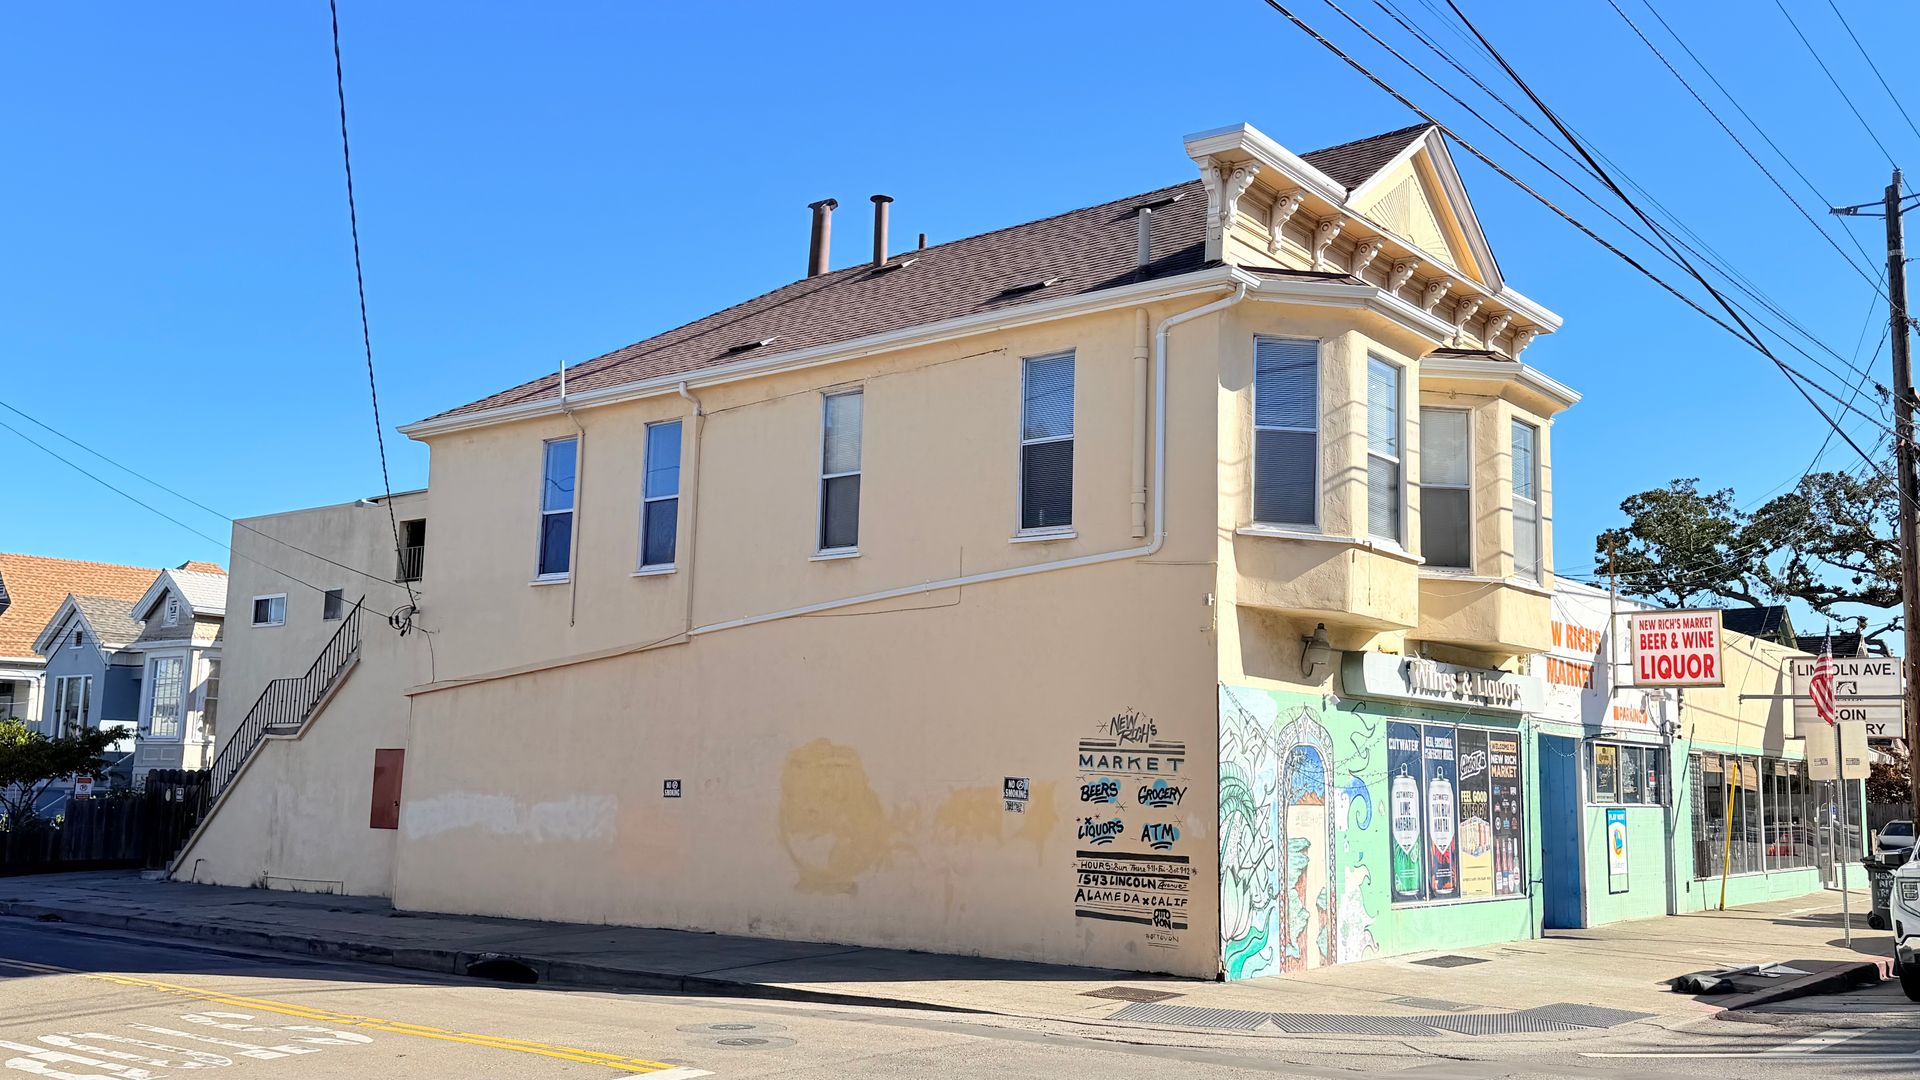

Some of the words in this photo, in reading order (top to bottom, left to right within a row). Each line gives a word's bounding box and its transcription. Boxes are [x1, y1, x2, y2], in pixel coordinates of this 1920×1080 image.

[1639, 620, 1656, 630] NEW
[1658, 619, 1681, 629] RICH'S
[1682, 617, 1713, 628] MARKET
[1566, 623, 1602, 655] RICH'S
[1640, 633, 1667, 650] BEER
[1671, 632, 1678, 649] &
[1682, 631, 1714, 648] WINE
[1546, 656, 1595, 690] MARKET
[1641, 654, 1715, 679] LIQUOR
[1797, 664, 1859, 676] LINOLN
[1863, 664, 1896, 676] AVE.
[1462, 671, 1473, 696] &
[1477, 675, 1521, 704] Liquors
[1109, 712, 1140, 736] NEW
[1388, 738, 1420, 752] CUTWATER
[1079, 754, 1185, 771] MARKET
[1491, 754, 1504, 764] NEW
[1505, 754, 1517, 765] RICH
[1491, 764, 1517, 778] MARKET
[1005, 789, 1027, 799] SMOKING
[1080, 782, 1119, 802] BEERS
[1138, 785, 1188, 806] GROCERY
[1460, 790, 1471, 802] FEEL
[1472, 790, 1488, 803] GOOD
[1141, 823, 1175, 843] ATM
[1079, 874, 1108, 886] 1543
[1109, 875, 1156, 890] LINCOLN
[1074, 888, 1140, 904] ALAMEDA
[1151, 895, 1188, 907] CALIF
